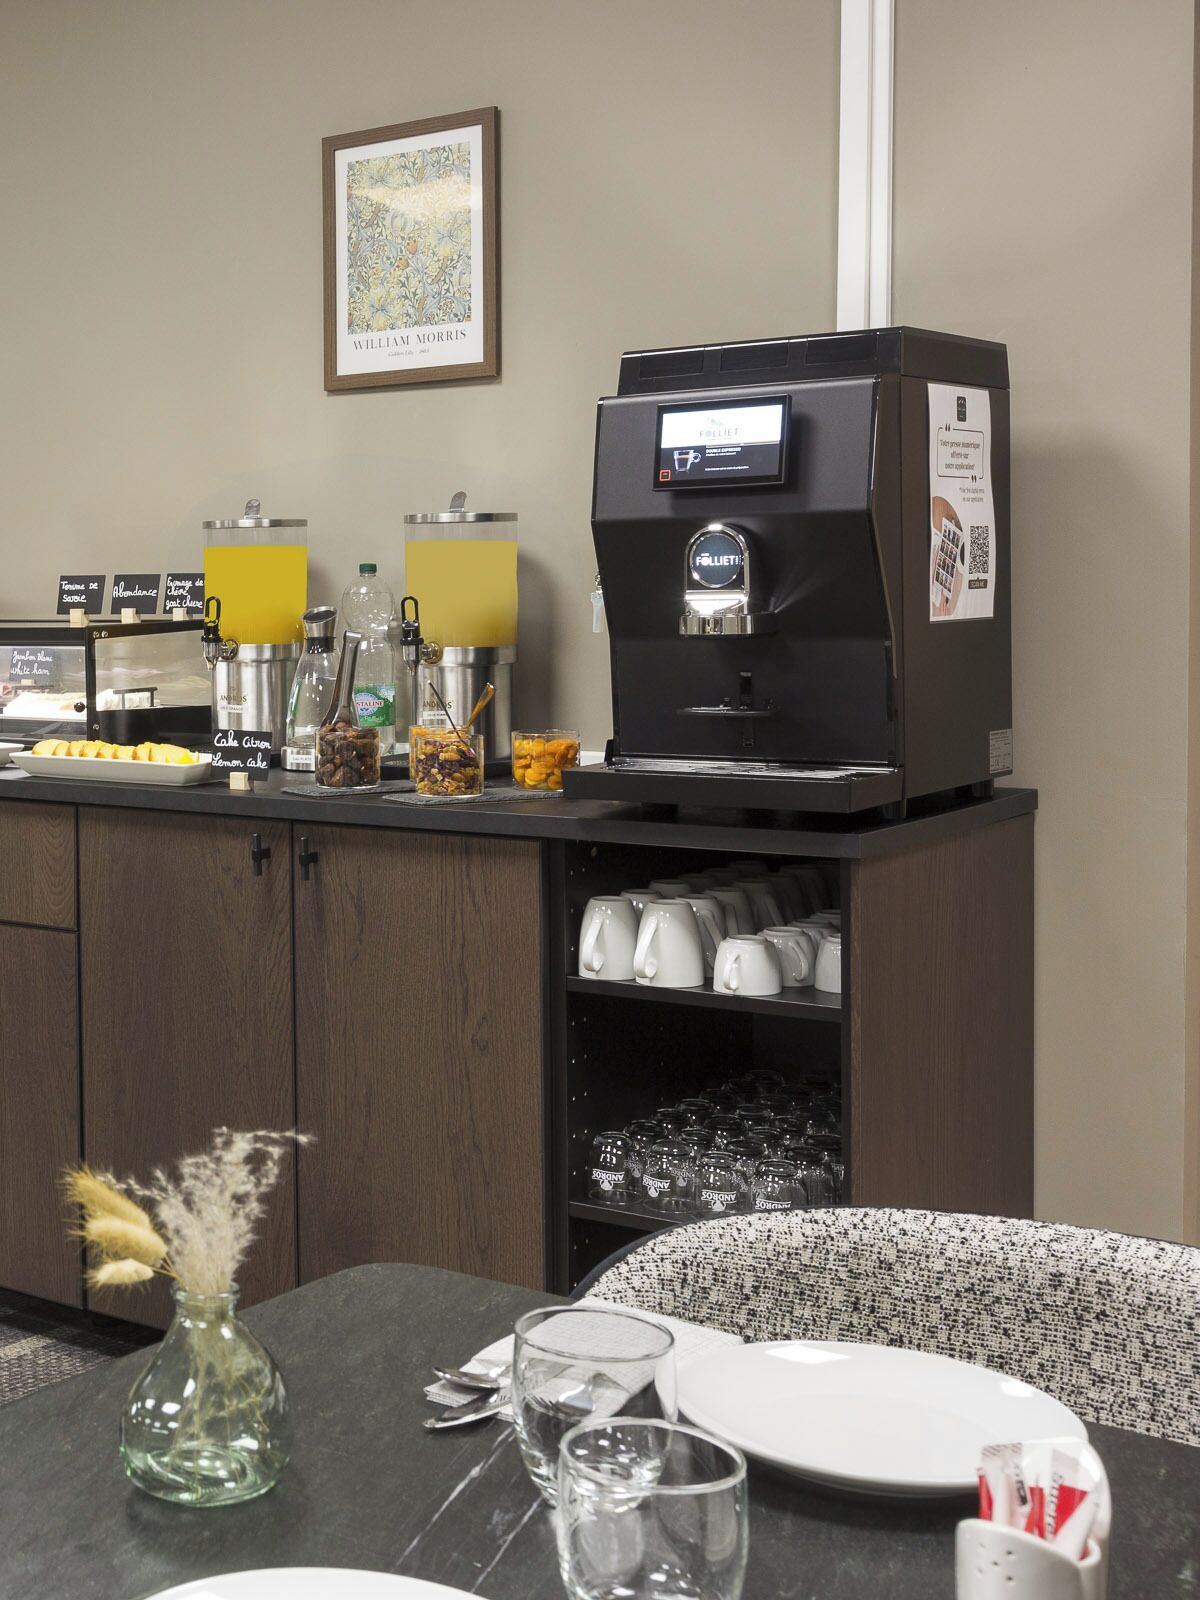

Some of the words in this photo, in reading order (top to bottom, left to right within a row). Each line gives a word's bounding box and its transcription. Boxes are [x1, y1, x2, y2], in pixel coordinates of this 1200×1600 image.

[353, 335, 409, 350] WILLIAM
[416, 329, 467, 344] MORRIS
[112, 581, 158, 598] Abondance
[214, 730, 239, 747] Cake
[243, 736, 272, 749] Citron
[212, 752, 244, 767] Lemon
[592, 1170, 625, 1182] ANDROS
[701, 1191, 736, 1202] ANDROS
